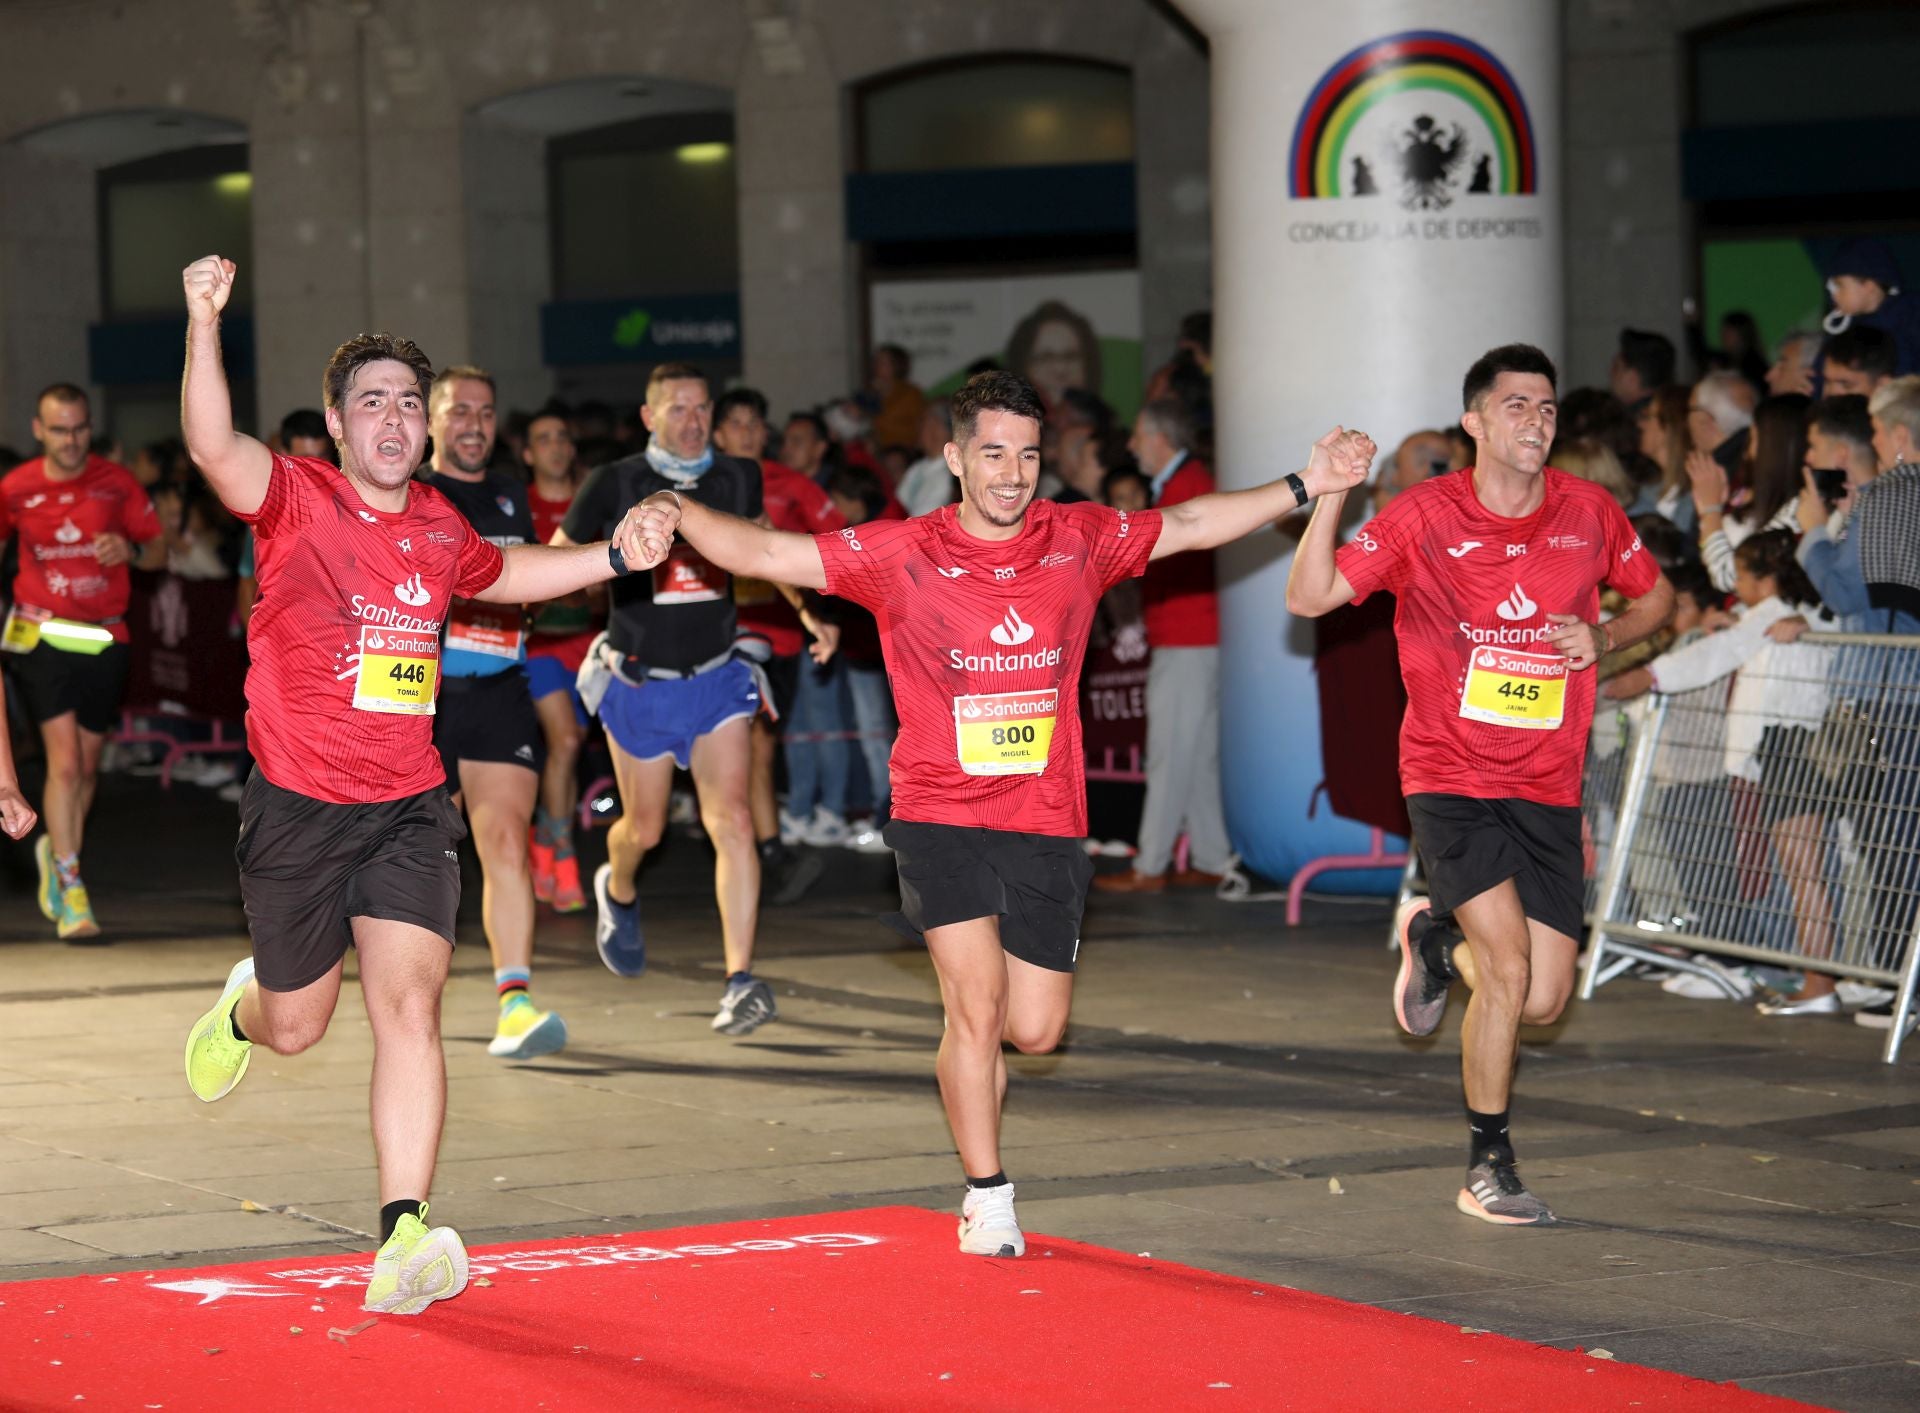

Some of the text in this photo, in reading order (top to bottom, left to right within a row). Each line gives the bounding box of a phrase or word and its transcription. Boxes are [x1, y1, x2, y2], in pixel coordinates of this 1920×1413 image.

[1287, 216, 1545, 243] CONCEJAA DE DEPORTES
[1459, 621, 1565, 644] Santand
[387, 635, 437, 654] Santander
[950, 646, 1062, 673] Santander
[1498, 656, 1564, 676] Santander
[389, 663, 425, 684] 446
[1497, 681, 1541, 701] 445
[984, 698, 1055, 717] Santander
[1505, 704, 1528, 713] JAIME
[991, 725, 1035, 746] 800
[1000, 749, 1031, 758] MIGUEL
[290, 1232, 882, 1289] Gesprox
